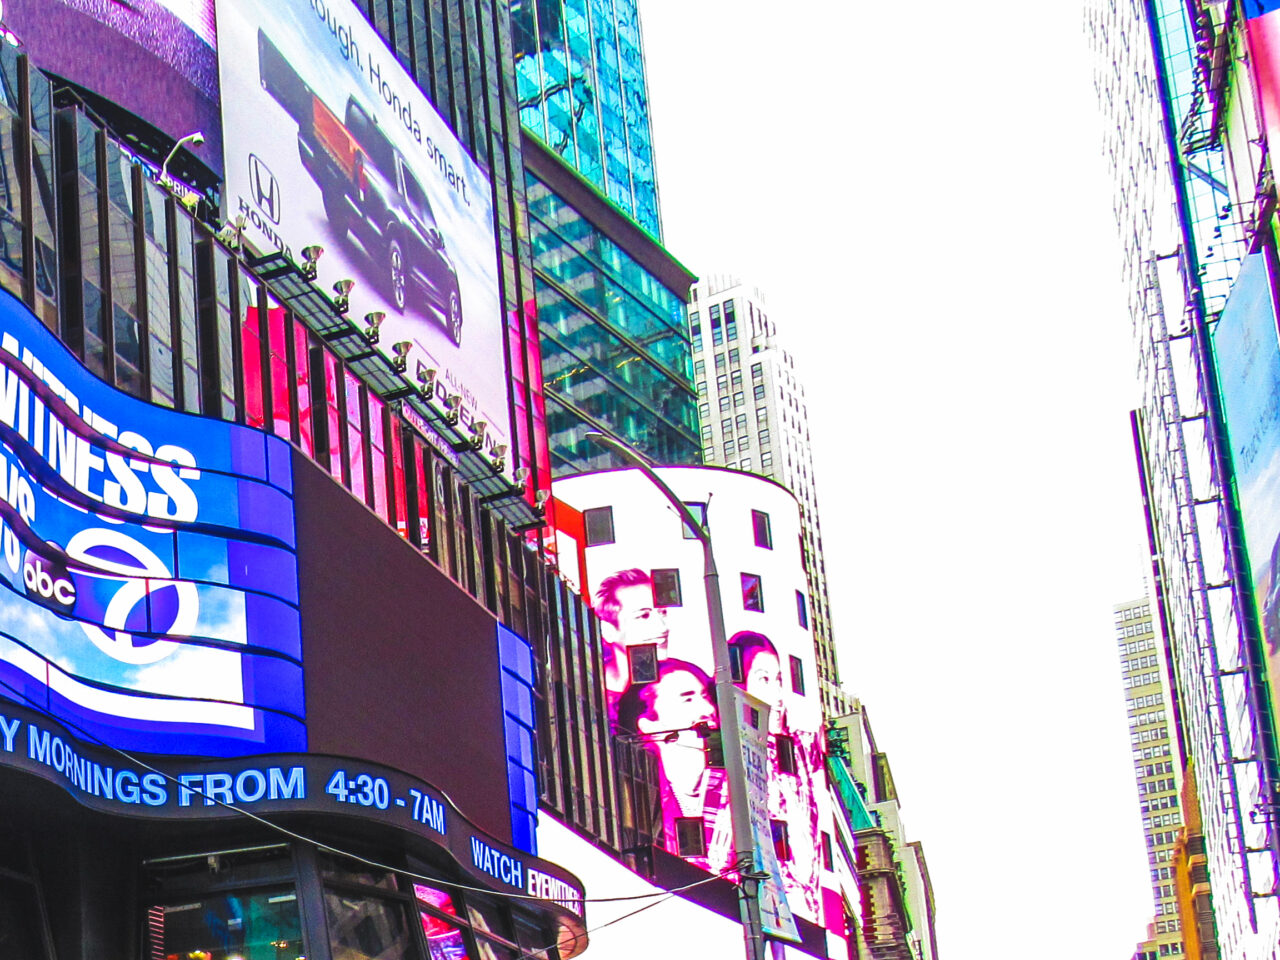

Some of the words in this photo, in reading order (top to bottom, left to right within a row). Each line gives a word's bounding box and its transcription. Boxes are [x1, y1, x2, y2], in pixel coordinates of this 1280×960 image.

[368, 53, 422, 145] Honda
[426, 136, 471, 207] smart.
[238, 195, 295, 262] HONDA
[23, 561, 76, 606] abc
[27, 724, 168, 807] MORNINGS
[177, 766, 306, 808] FROM
[325, 769, 390, 810] 4:30
[409, 787, 446, 836] 7AM
[471, 835, 523, 889] WATCH
